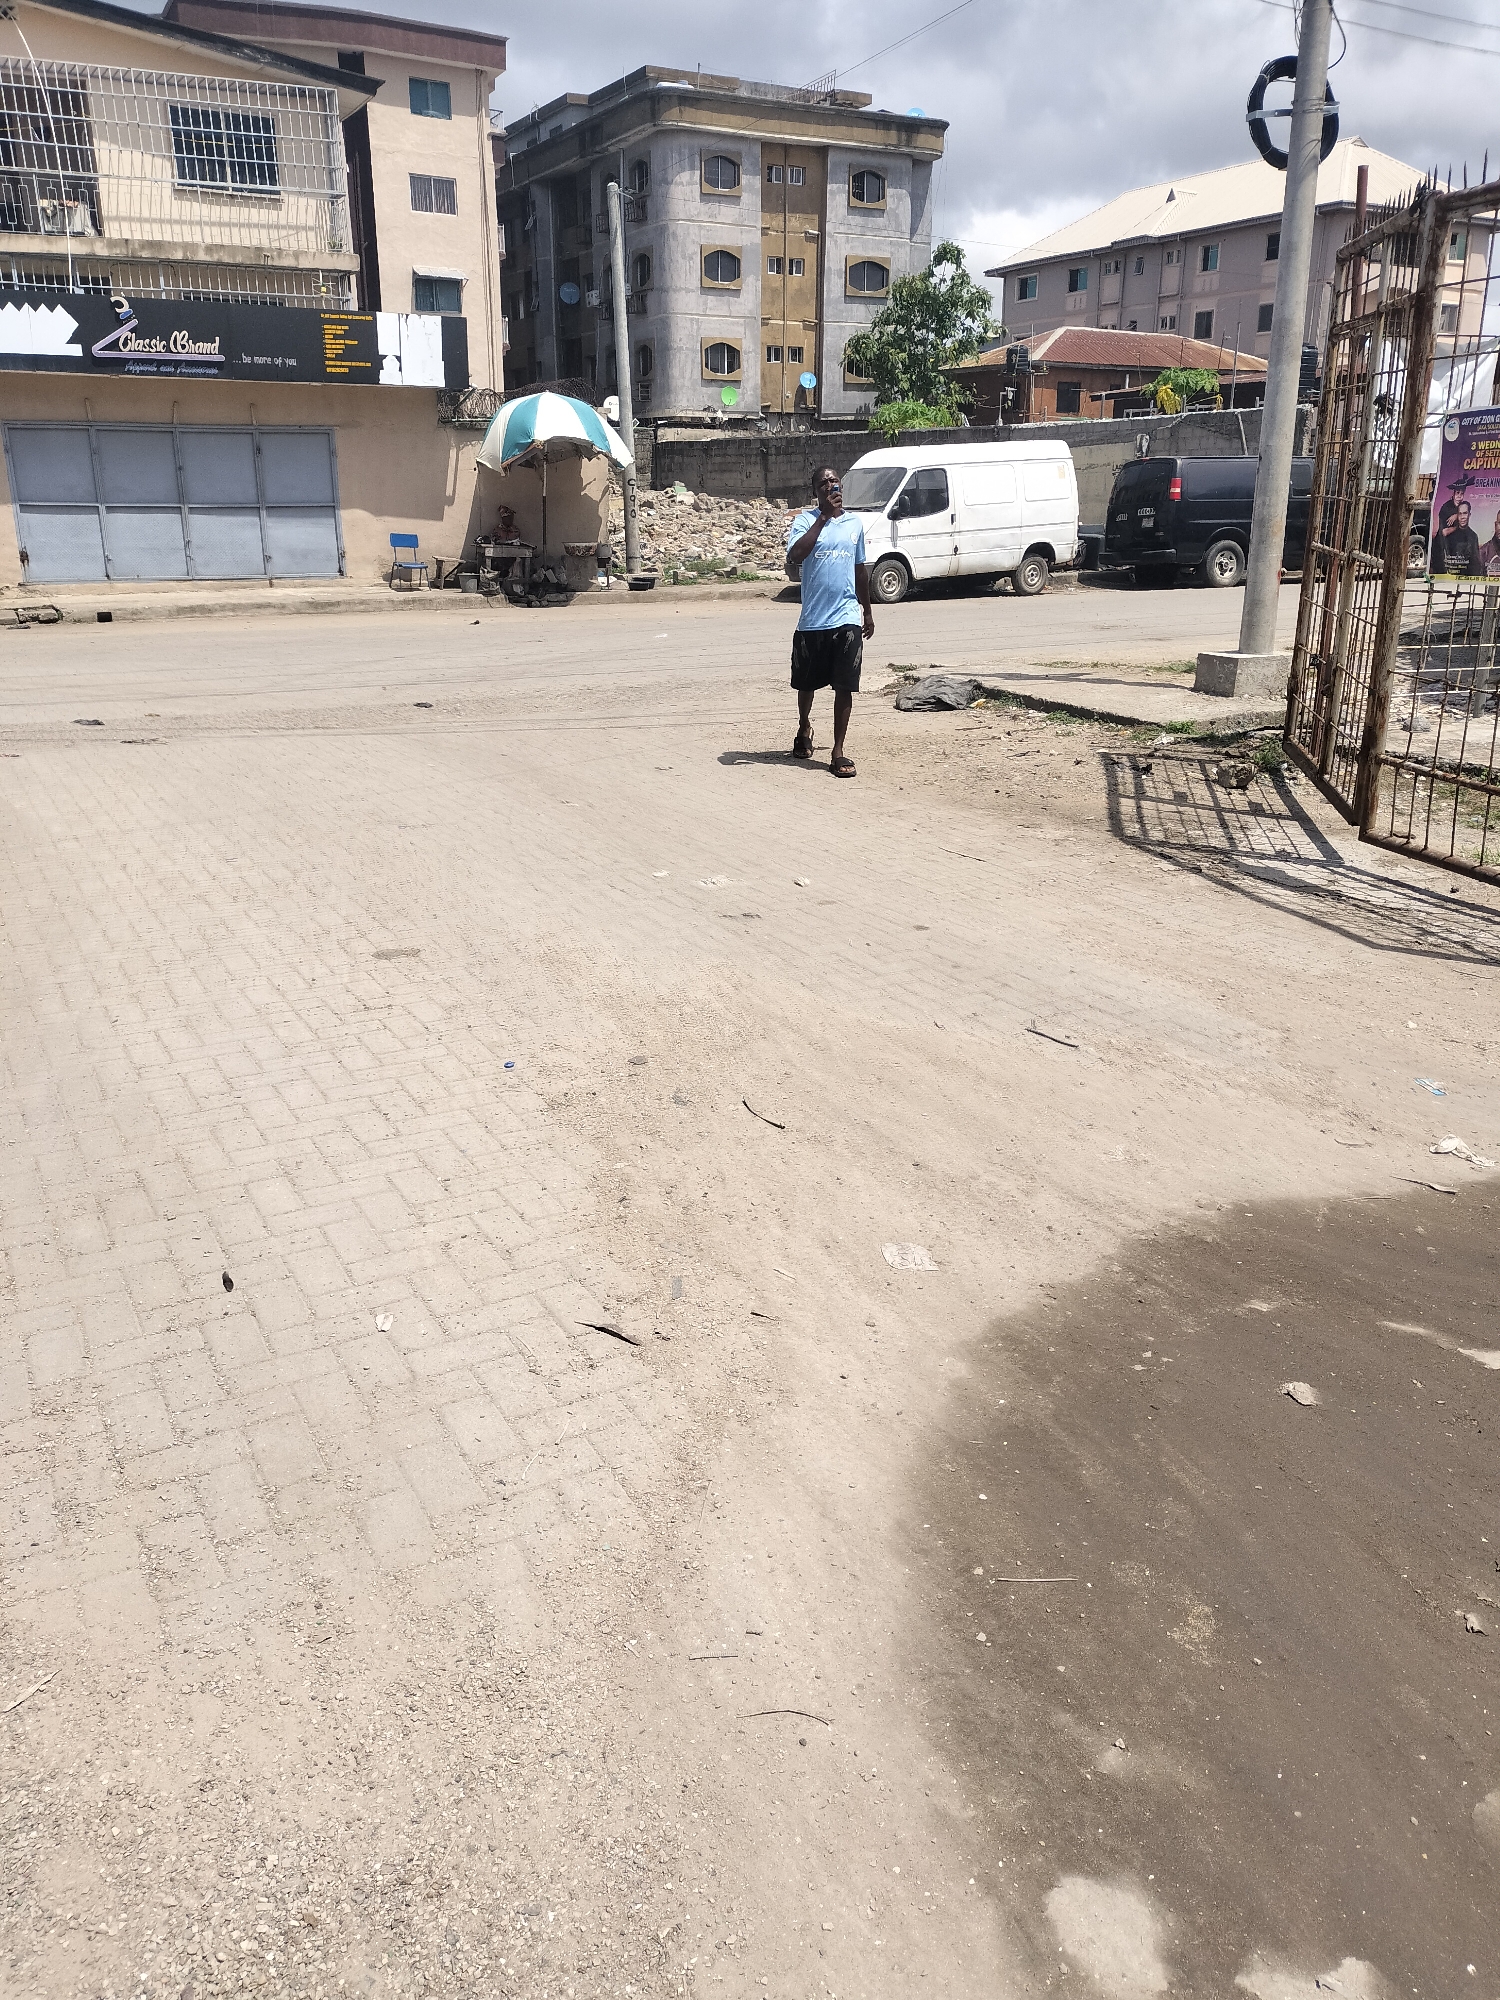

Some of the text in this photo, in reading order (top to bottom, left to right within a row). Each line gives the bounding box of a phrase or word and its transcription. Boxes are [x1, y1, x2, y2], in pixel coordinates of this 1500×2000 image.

[118, 330, 220, 354] Classic Brand
[253, 355, 272, 364] more
[273, 356, 283, 367] of
[283, 357, 297, 367] you
[1461, 417, 1474, 425] CITY
[1473, 416, 1482, 424] OF
[1481, 415, 1495, 424] ZION
[1470, 441, 1477, 450] 3
